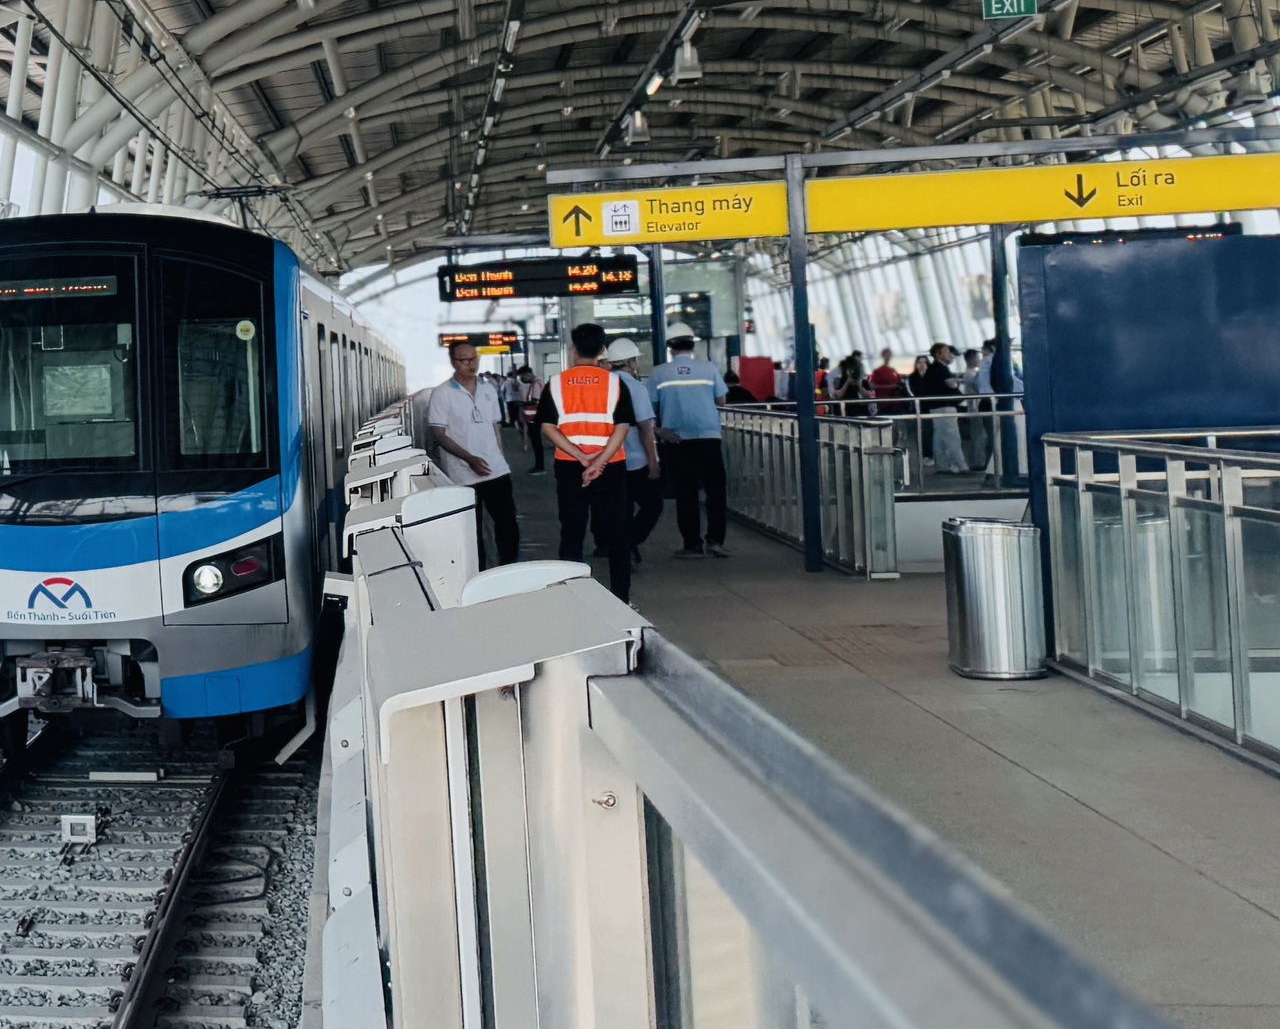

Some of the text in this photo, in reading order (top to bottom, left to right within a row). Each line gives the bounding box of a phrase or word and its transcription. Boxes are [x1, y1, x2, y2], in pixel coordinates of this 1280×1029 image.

[1116, 168, 1175, 188] Lối ra
[646, 193, 753, 216] Thang máy
[1117, 194, 1144, 207] Exit
[646, 221, 702, 233] Elevator
